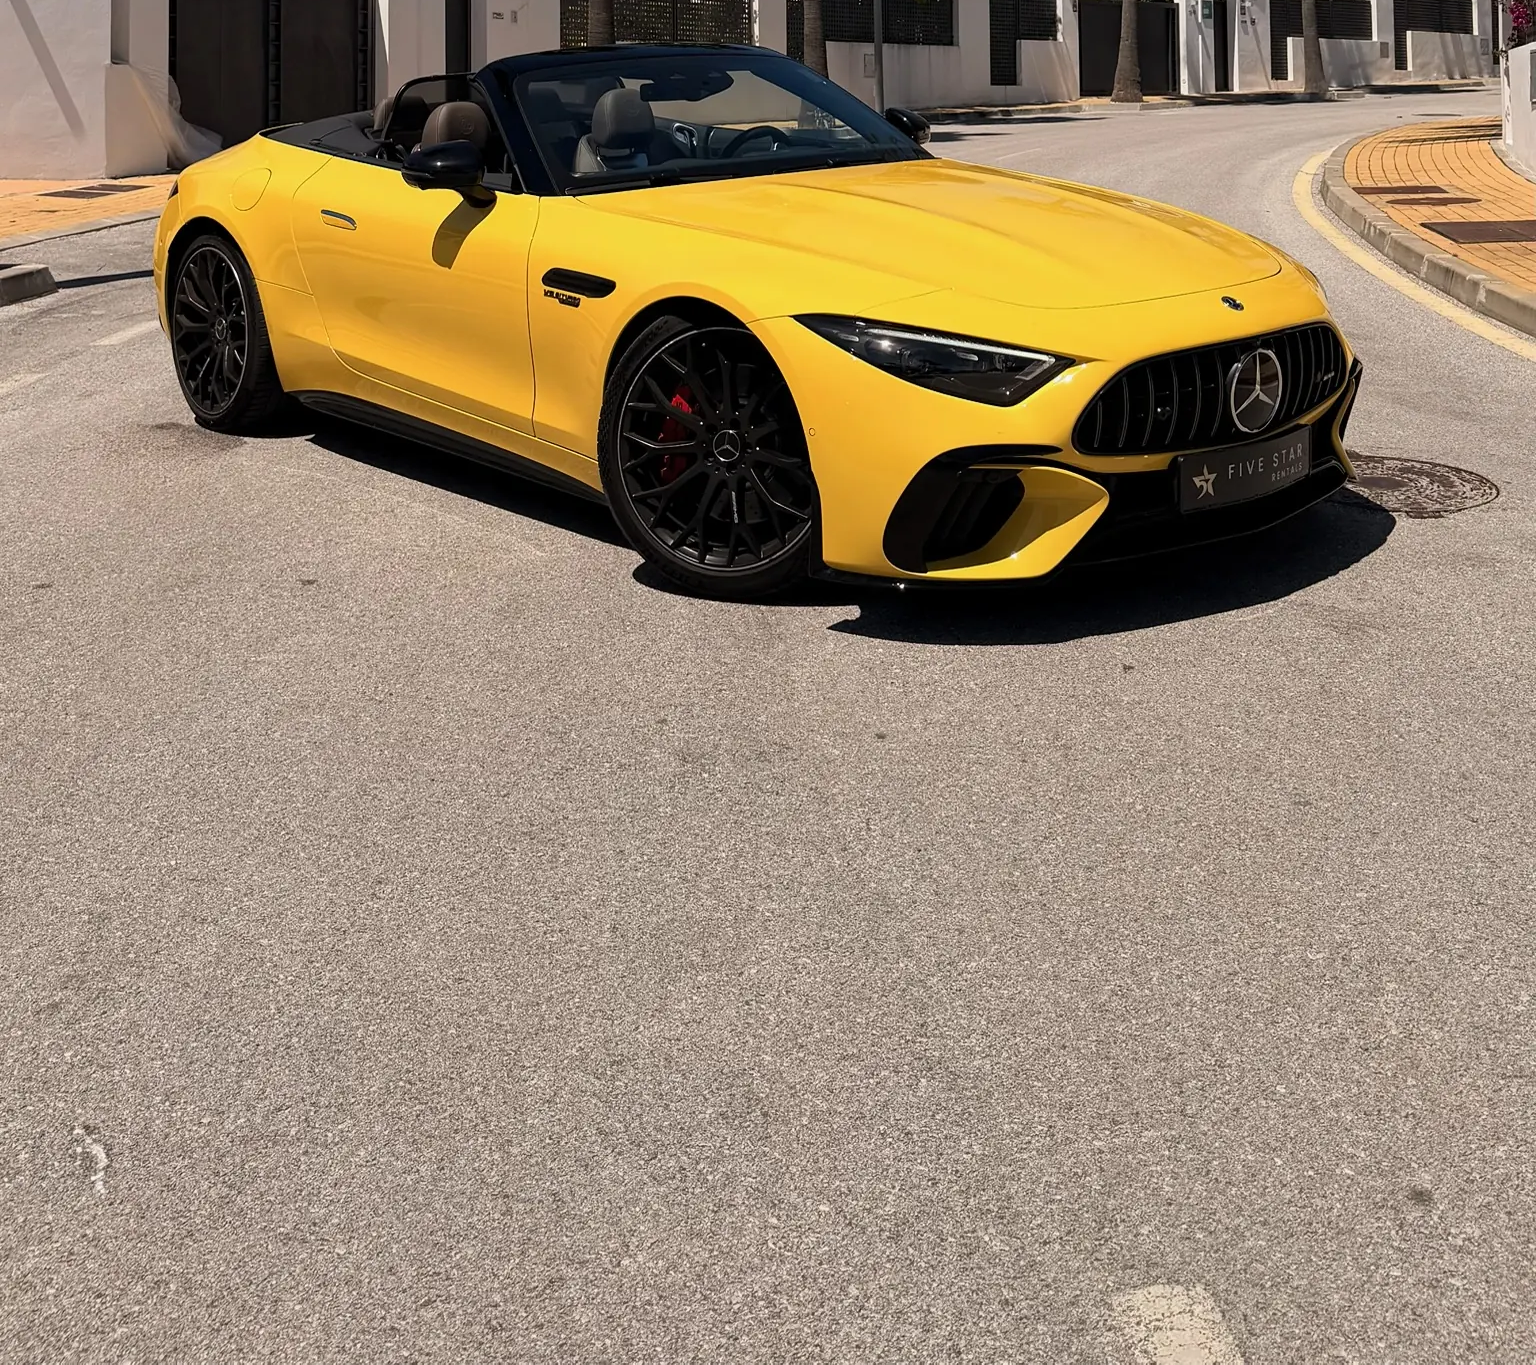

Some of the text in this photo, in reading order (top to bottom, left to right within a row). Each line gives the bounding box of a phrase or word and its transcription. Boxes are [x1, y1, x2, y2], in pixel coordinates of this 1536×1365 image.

[1228, 443, 1303, 479] FIVE STAR
[1271, 461, 1303, 482] RENTALS
